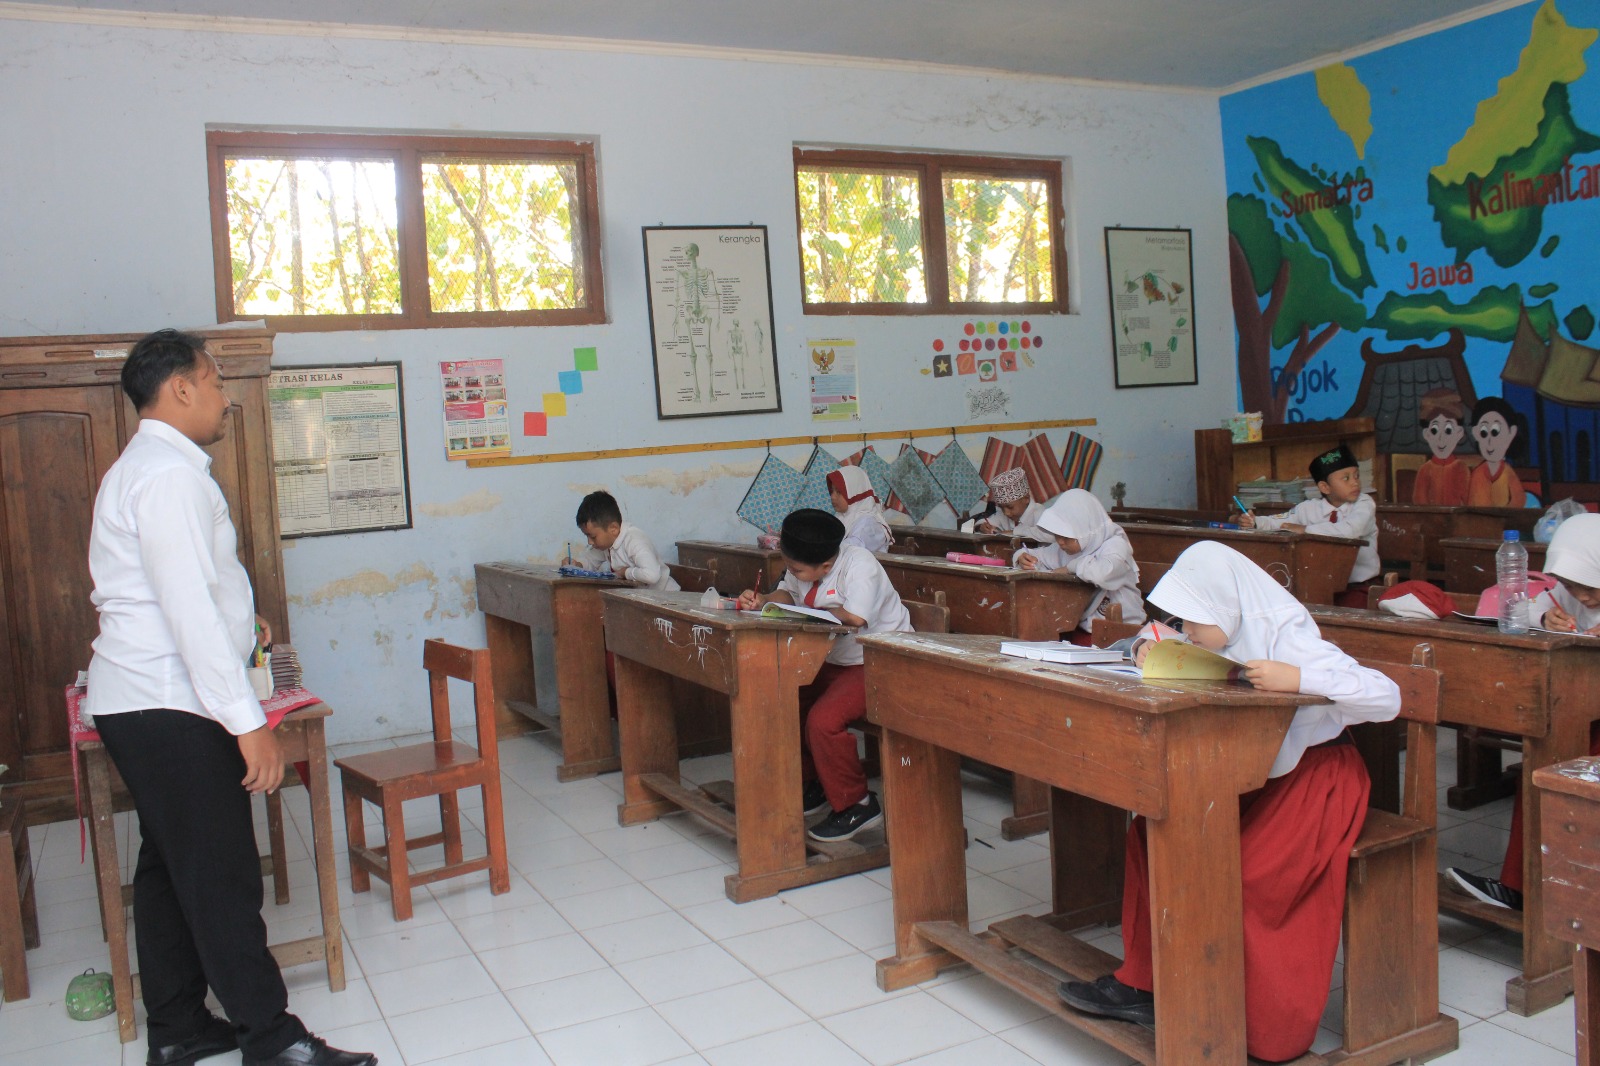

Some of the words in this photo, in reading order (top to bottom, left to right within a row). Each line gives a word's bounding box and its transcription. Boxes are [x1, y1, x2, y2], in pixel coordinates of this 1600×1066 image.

[1281, 172, 1374, 219] Sumatra
[718, 235, 761, 245] Kerangka
[1406, 261, 1474, 291] Jawa
[310, 373, 343, 382] KELAS
[1271, 359, 1340, 405] Pojok
[901, 756, 911, 767] M
